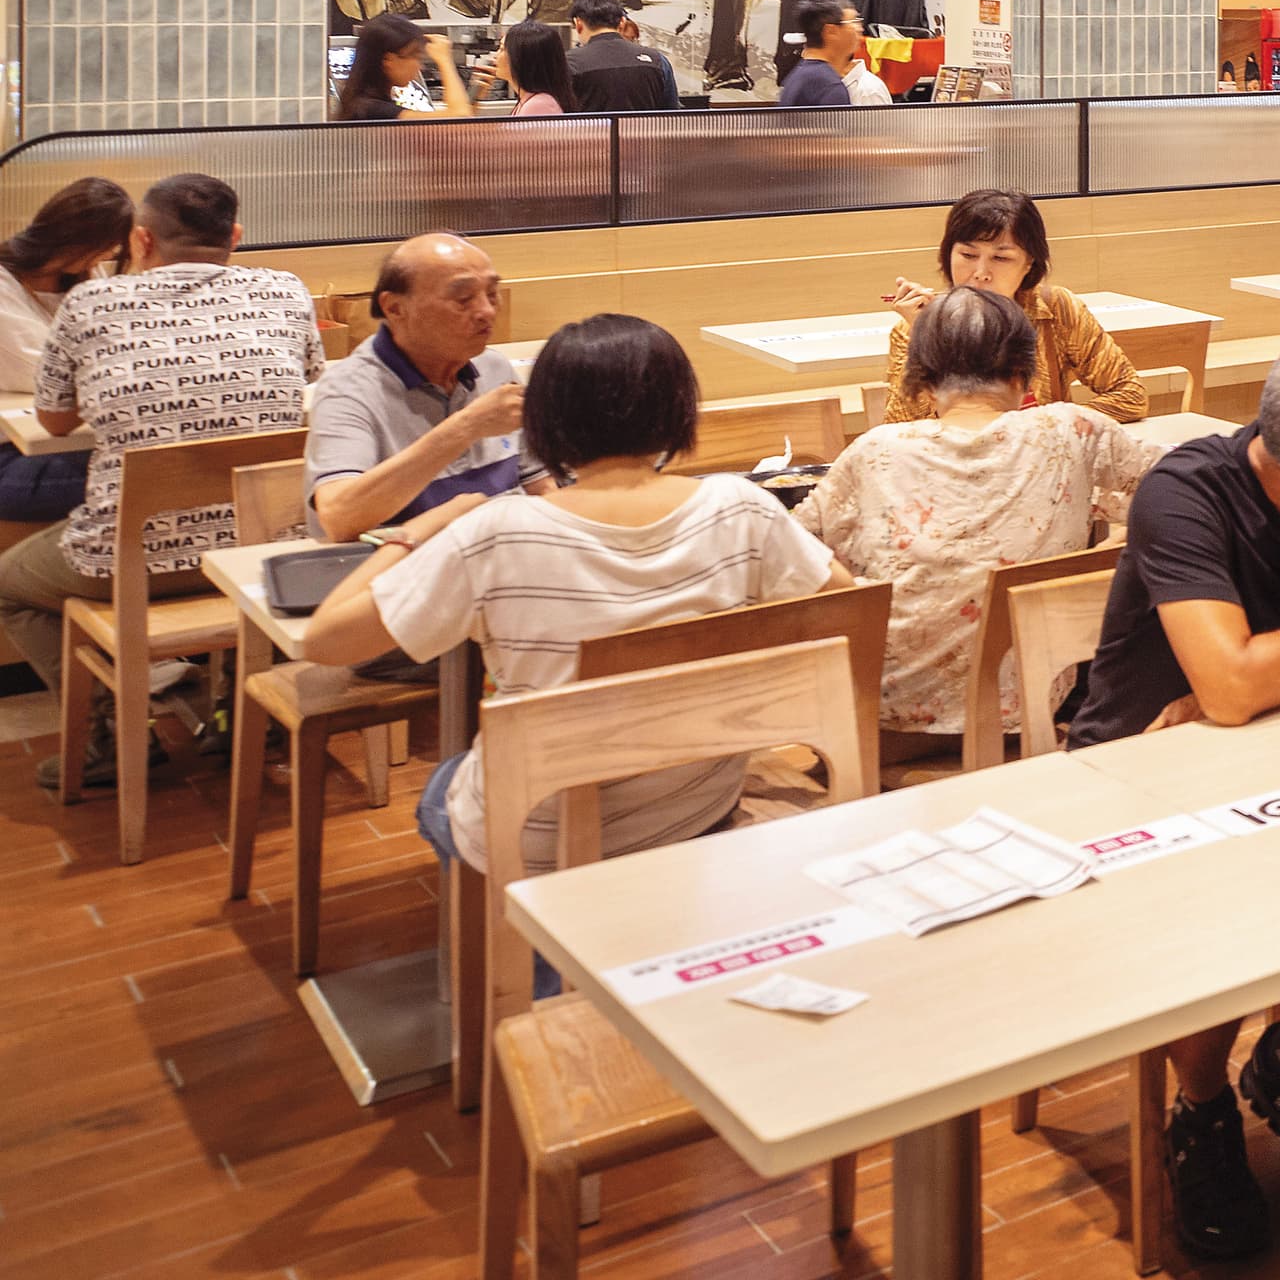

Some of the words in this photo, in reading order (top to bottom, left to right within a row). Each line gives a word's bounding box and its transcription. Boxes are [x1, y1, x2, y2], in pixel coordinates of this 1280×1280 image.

[92, 301, 150, 316] PUMA
[172, 296, 229, 310] PUMA
[247, 290, 294, 302] PUMA
[130, 318, 193, 331] PUMA
[214, 311, 268, 324] PUMA
[96, 341, 151, 358] PUMA
[175, 331, 236, 346] PUMA
[132, 355, 197, 371] PUMA
[219, 348, 275, 362] PUMA
[100, 381, 154, 400] PUMA
[178, 371, 241, 387] PUMA
[137, 398, 199, 417] PUMA
[221, 389, 278, 405] PUMA
[107, 427, 160, 446] PUMA
[180, 417, 239, 434] PUMA
[176, 508, 236, 527] PUMA
